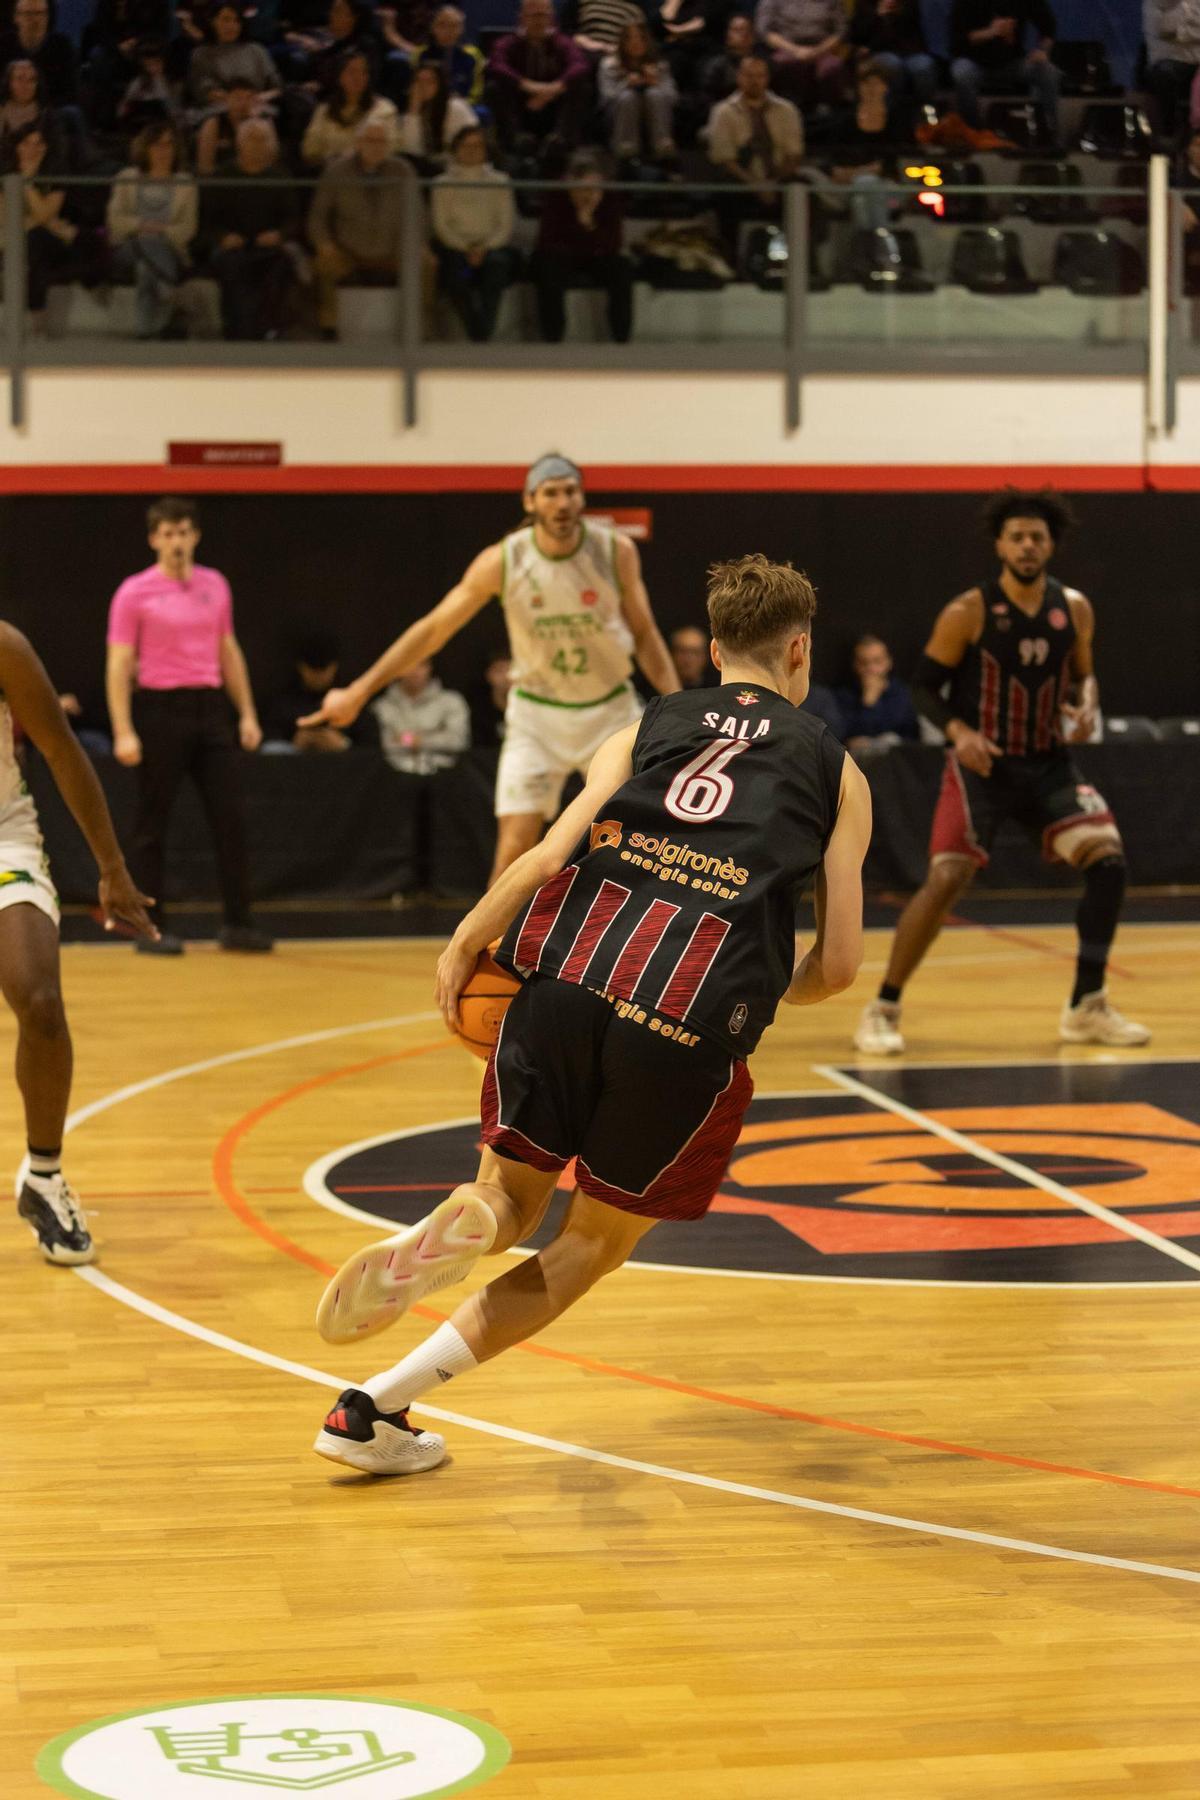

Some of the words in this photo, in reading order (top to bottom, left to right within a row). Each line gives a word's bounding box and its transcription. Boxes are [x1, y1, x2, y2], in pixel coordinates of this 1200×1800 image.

[551, 647, 589, 677] 42
[1018, 637, 1050, 667] 99
[702, 711, 772, 740] SALA
[664, 738, 750, 824] 6
[629, 832, 750, 886] solgironès
[620, 851, 688, 885] energia
[691, 877, 741, 900] solar
[648, 1018, 701, 1047] solar
